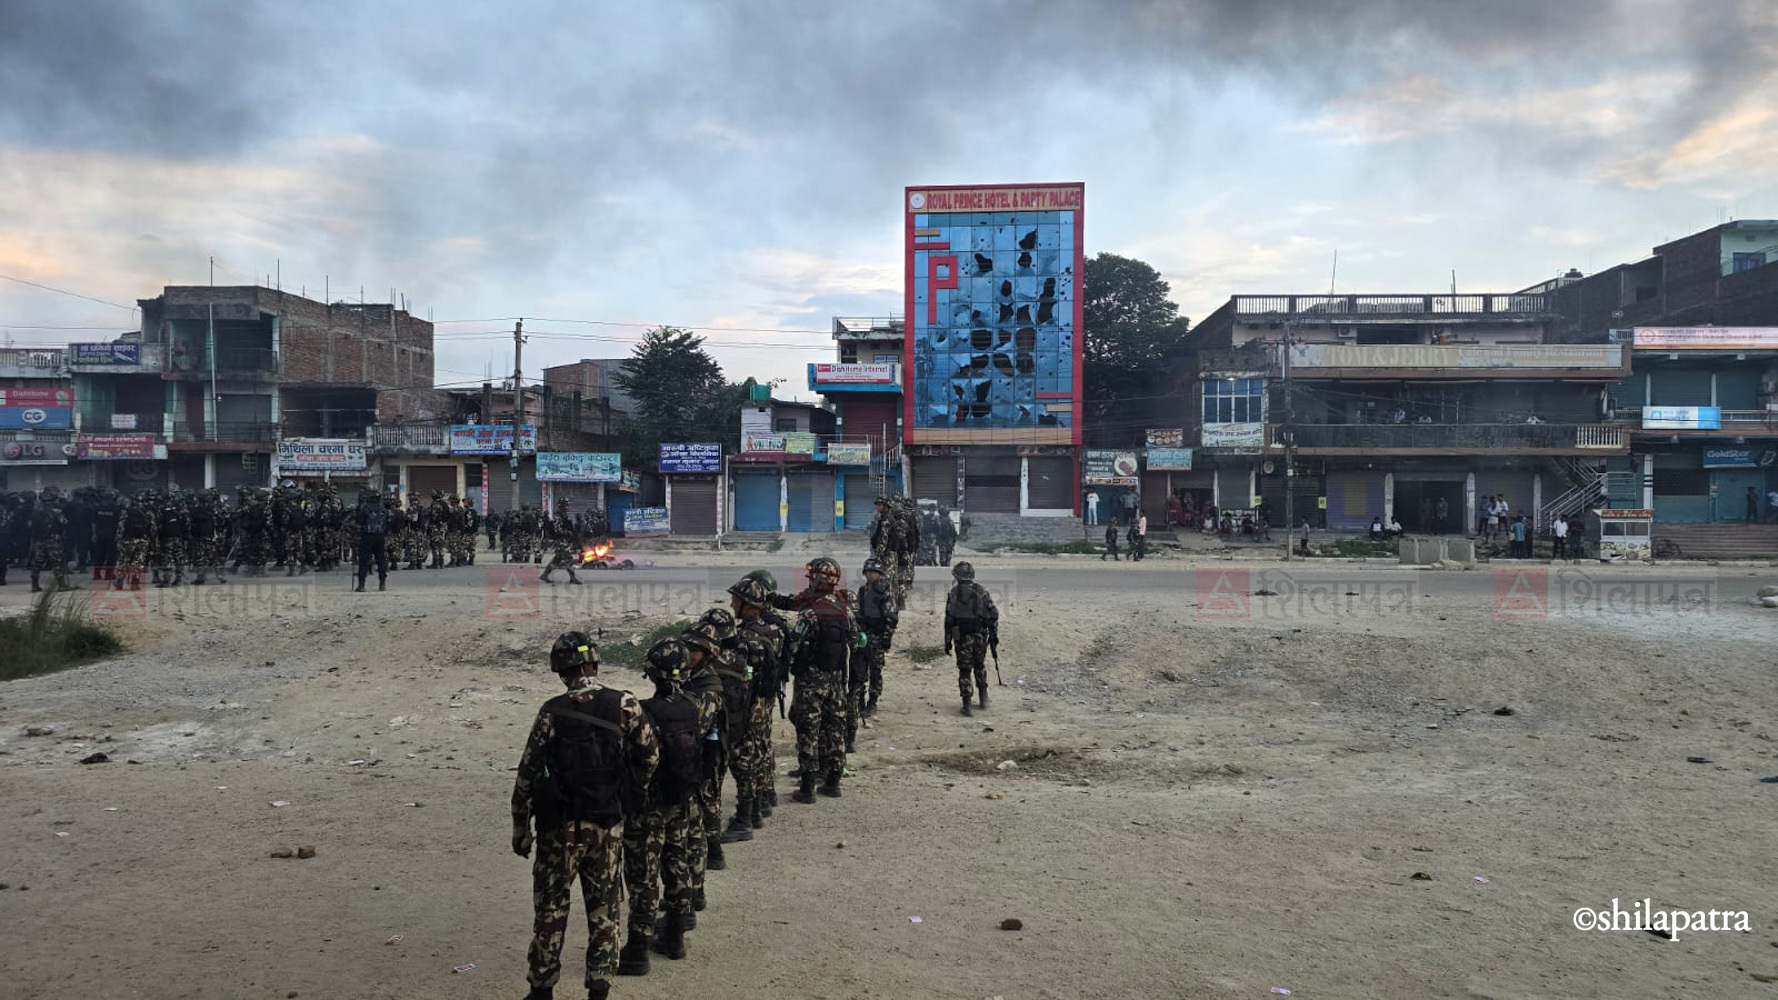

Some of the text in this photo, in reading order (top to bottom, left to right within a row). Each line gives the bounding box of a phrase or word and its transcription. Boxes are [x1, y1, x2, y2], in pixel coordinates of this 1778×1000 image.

[927, 193, 951, 210] ROYAL
[954, 192, 982, 209] PRINCE
[984, 191, 1010, 208] HOTEL
[1012, 191, 1018, 207] &
[1048, 190, 1080, 207] PALACE
[24, 411, 42, 421] CG
[22, 444, 43, 456] LG
[278, 442, 363, 454] मिथिला चश्मा घर
